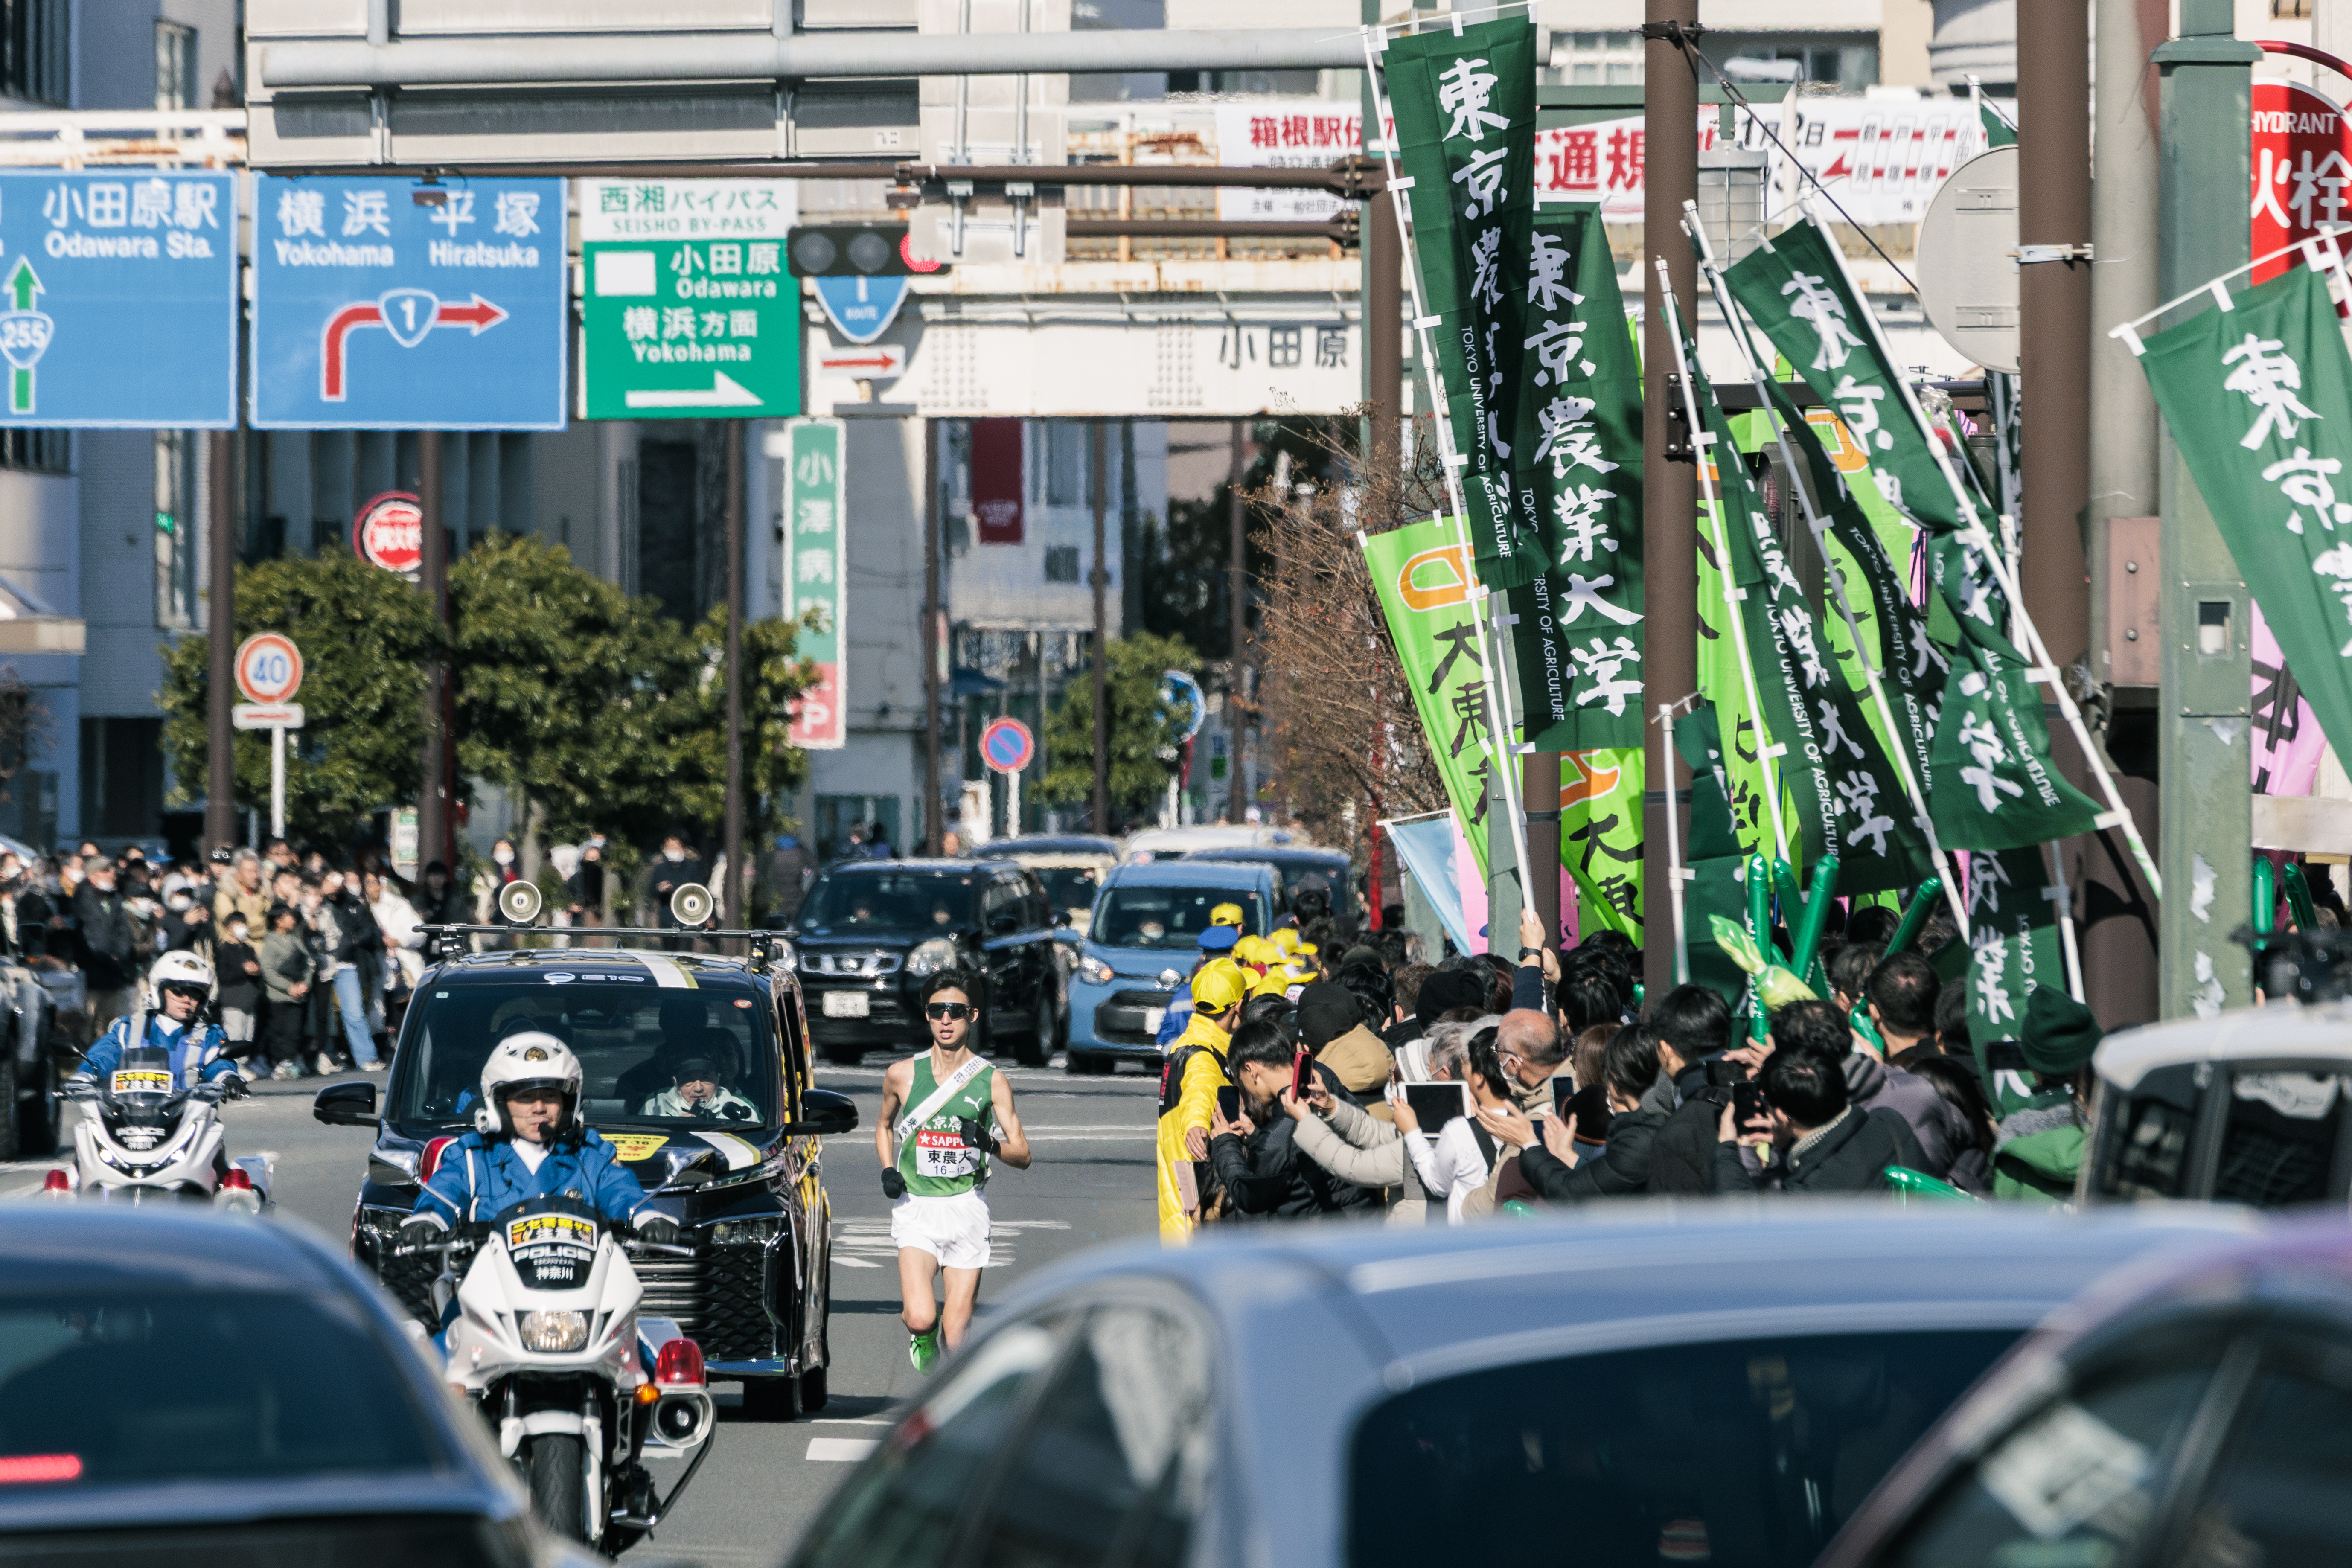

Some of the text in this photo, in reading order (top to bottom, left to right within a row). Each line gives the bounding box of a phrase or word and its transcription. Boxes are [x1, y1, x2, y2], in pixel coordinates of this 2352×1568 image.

[1250, 116, 1393, 148] 箱根駅伝
[43, 178, 219, 229] 小田原駅
[277, 189, 391, 237] 横浜
[430, 190, 541, 237] 平塚
[600, 186, 779, 213] 西湘バイパス
[613, 218, 768, 233] SEISHO BY-PASS
[44, 231, 215, 259] Odawara Sta.
[274, 239, 394, 266] Yokohama
[429, 239, 540, 268] Hiratsuka
[670, 242, 781, 276] 小田原
[675, 278, 777, 299] Odawara
[400, 298, 416, 332] 1
[623, 307, 758, 340] 横浜方面
[1, 321, 48, 348] 255
[1220, 326, 1348, 369] 小田原
[631, 342, 751, 363] Yokohama
[1461, 325, 1511, 558] TOKYO UNIVERSITY OF AGRICULTURE
[1524, 230, 1645, 717] 東京農業大学
[1849, 527, 1882, 573] TOKYO
[1540, 616, 1553, 634] OF
[1879, 579, 1907, 661] UNIVERSITY
[253, 655, 288, 684] 40
[1543, 638, 1565, 721] AGRICULTURE
[1898, 667, 1912, 688] OF
[1779, 659, 1815, 739] UNIVERSITY
[1804, 742, 1823, 764] OF
[1903, 692, 1932, 790] AGRICULTURE
[928, 1150, 971, 1164] 東農大
[934, 1165, 964, 1175] 16-12
[536, 1227, 573, 1240] 注意
[514, 1245, 591, 1262] POLICE
[533, 1257, 576, 1266] HONDA
[536, 1266, 573, 1280] 神奈川
